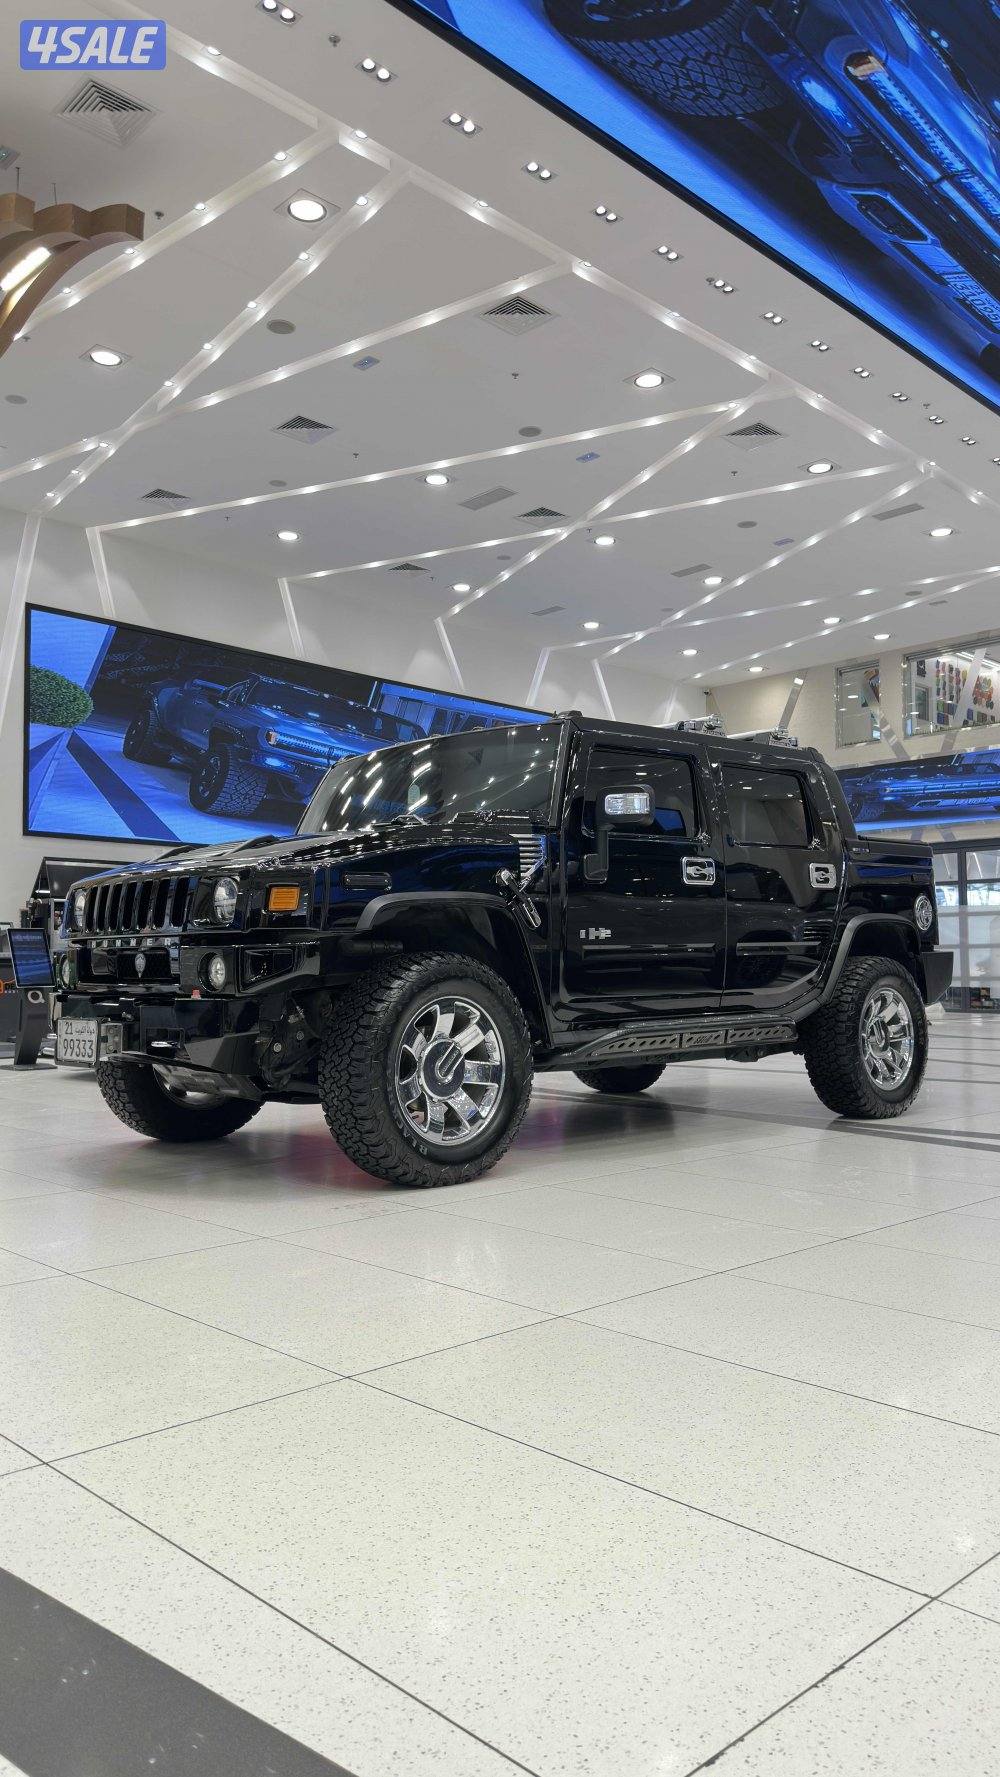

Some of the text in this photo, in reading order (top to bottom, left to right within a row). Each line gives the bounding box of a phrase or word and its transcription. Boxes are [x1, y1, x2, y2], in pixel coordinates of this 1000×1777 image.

[91, 937, 172, 949] HUMMER
[65, 1022, 74, 1035] 21
[63, 1038, 94, 1059] 99333
